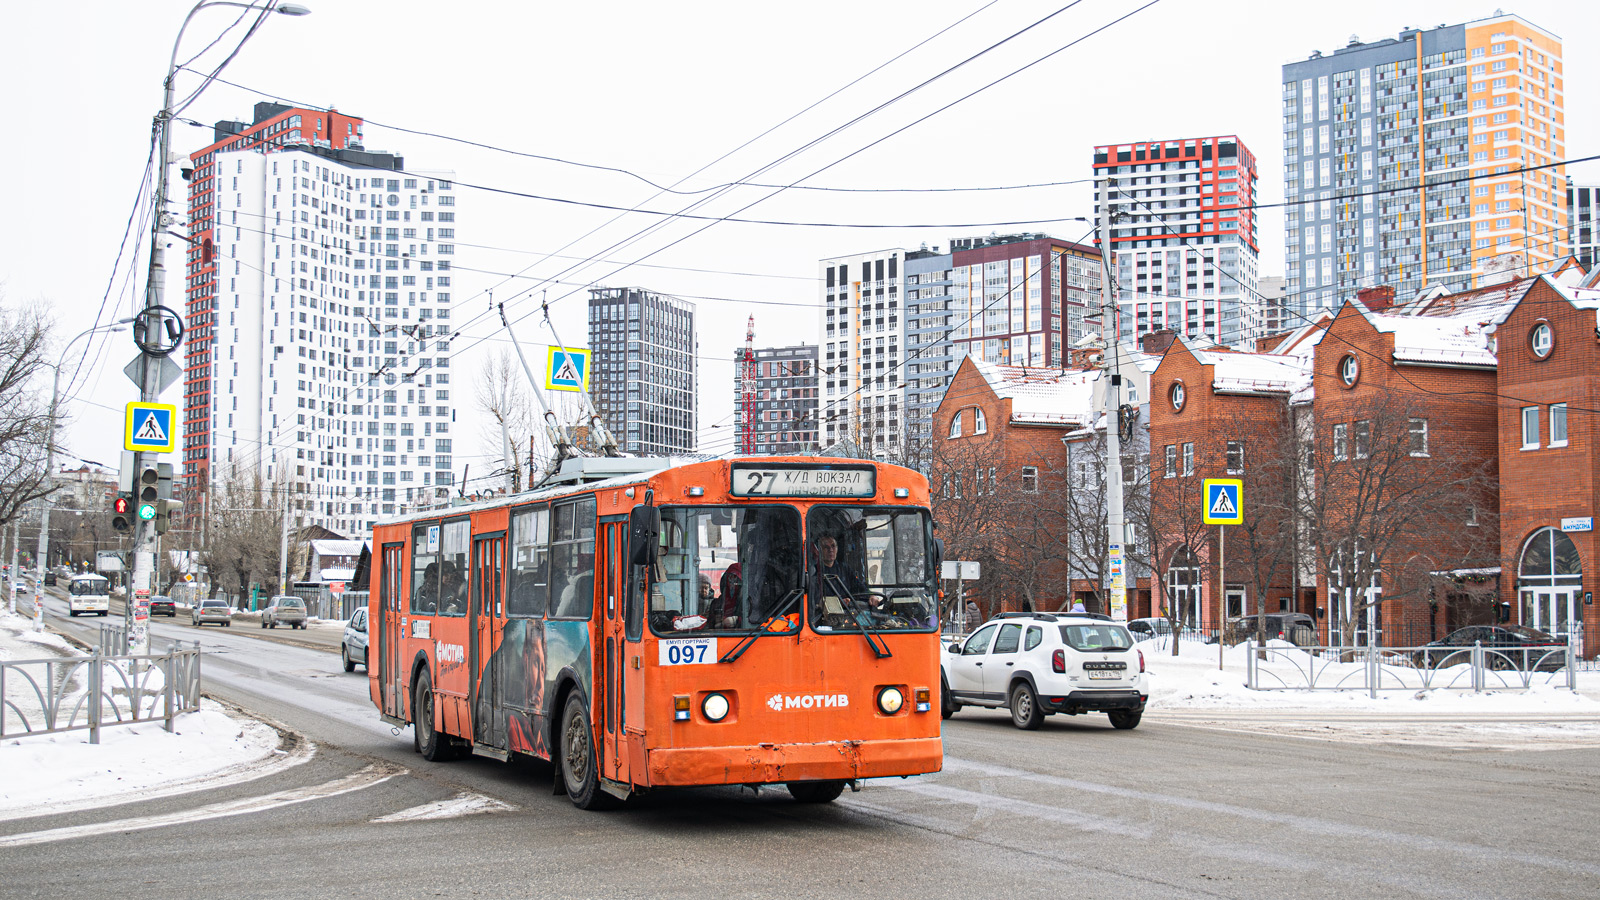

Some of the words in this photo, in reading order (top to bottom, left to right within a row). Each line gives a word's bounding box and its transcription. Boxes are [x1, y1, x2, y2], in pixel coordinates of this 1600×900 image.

[747, 472, 778, 494] 27
[784, 471, 809, 483] Ж/Д
[816, 472, 860, 483] ВОКЗАЛ
[441, 643, 464, 663] МОТИВ
[668, 645, 708, 664] 097
[785, 694, 849, 709] МОТИВ
